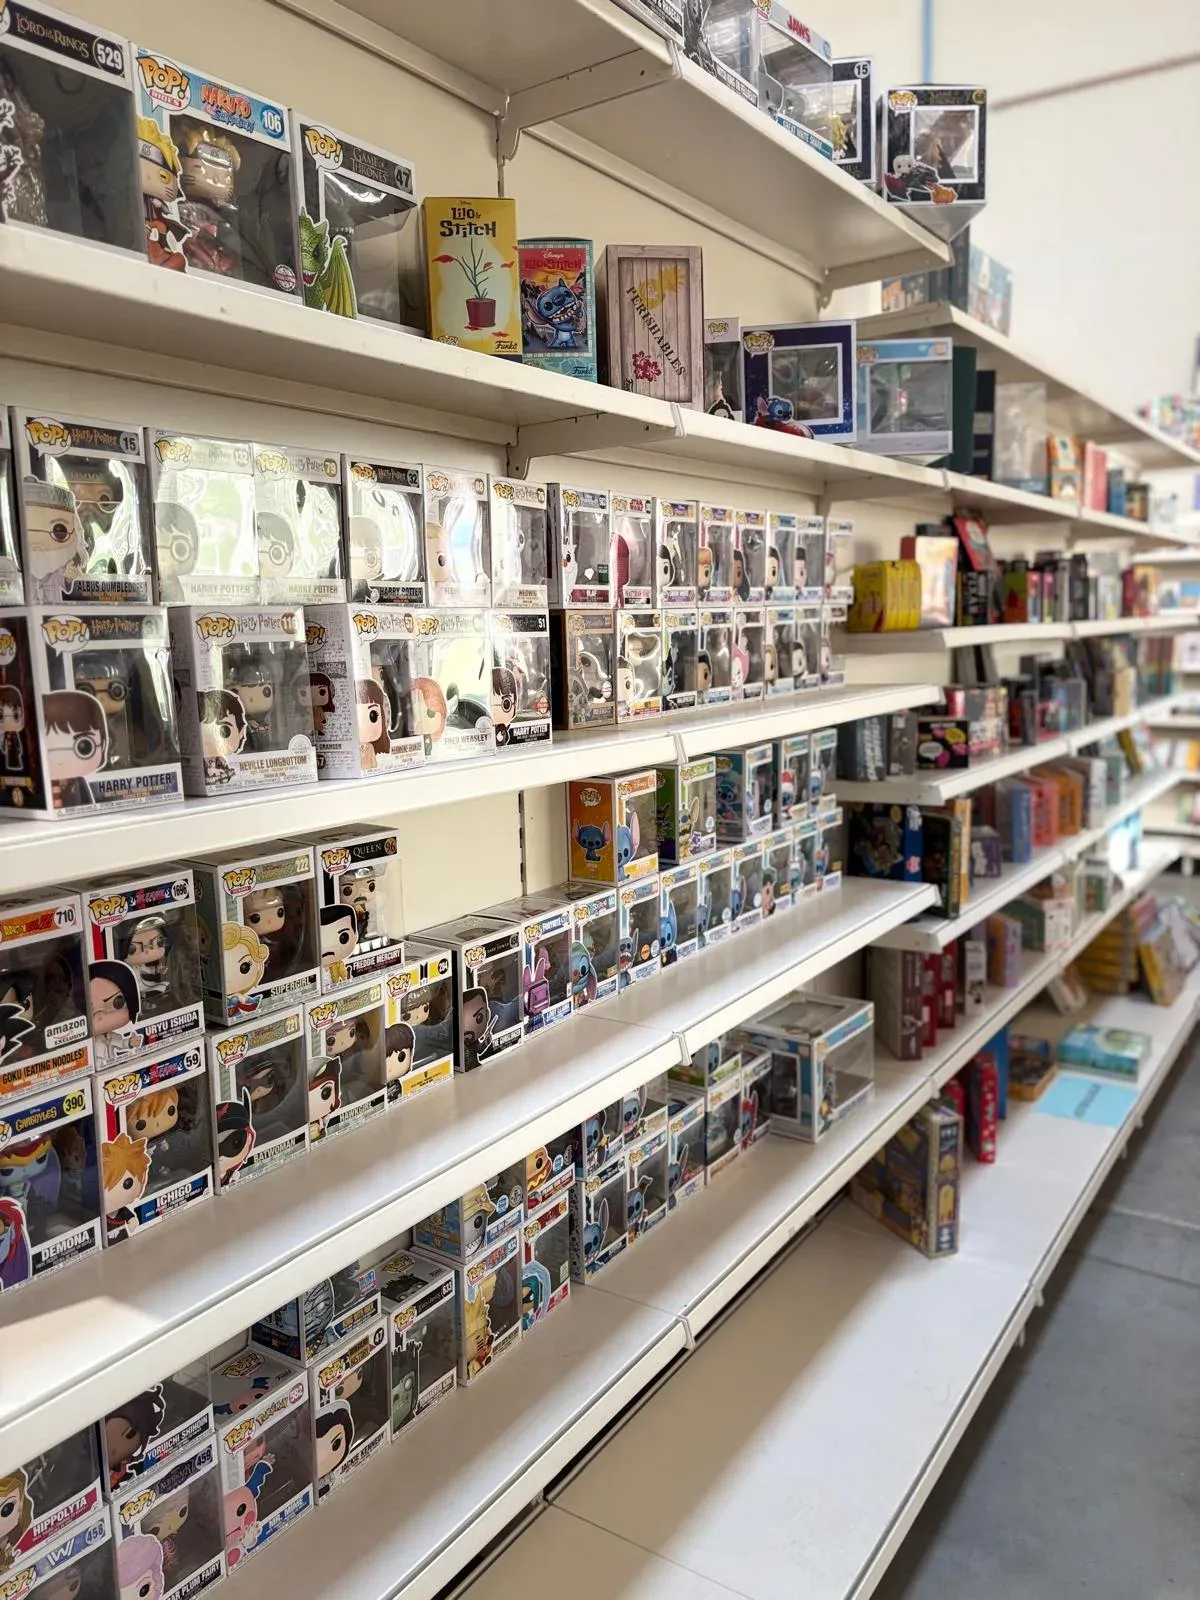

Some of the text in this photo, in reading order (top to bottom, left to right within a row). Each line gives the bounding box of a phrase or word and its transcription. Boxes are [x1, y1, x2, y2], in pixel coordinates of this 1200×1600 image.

[787, 14, 811, 44] JAWS
[16, 13, 122, 70] LORD RINGS 529
[136, 57, 190, 100] POP!
[856, 64, 868, 75] 15
[201, 84, 282, 132] NARUTO 106
[305, 129, 342, 163] POP!
[350, 158, 389, 183] THRONES
[352, 148, 410, 188] GAME 47
[626, 286, 686, 377] PERISHABLES
[708, 320, 729, 335] POP!
[494, 340, 518, 351] Funko
[743, 333, 774, 349] POP!
[572, 366, 594, 376] Funko
[25, 421, 71, 448] POP!
[71, 428, 136, 451] Harry Potter 15
[154, 439, 191, 463] POP!
[235, 450, 249, 465] 132
[256, 453, 288, 475] POP!
[325, 460, 336, 474] 79
[350, 465, 376, 484] POP!
[408, 473, 418, 485] 32
[426, 474, 449, 493] POP!
[475, 480, 484, 493] 88
[493, 483, 515, 500] POP!
[630, 498, 645, 506] STAR
[630, 505, 645, 513] WARS
[77, 581, 99, 593] ALBUS
[190, 584, 249, 594] HARRY POTTER
[288, 584, 338, 594] HARRY POTTER
[379, 587, 423, 597] HARRY POTTER
[41, 619, 87, 643] POP!
[90, 618, 114, 634] Harry
[114, 617, 140, 634] Potter
[195, 616, 237, 641] POP!
[236, 613, 281, 635] Harry Potter
[353, 613, 378, 634] POP!
[538, 618, 546, 628] 51
[444, 734, 488, 746] FRED WEASLEY
[513, 724, 548, 737] HARRY POTTER
[319, 742, 343, 750] GRANGER
[238, 755, 307, 771] NEVILLE LONGBOTTOM
[98, 775, 134, 793] HARRY
[135, 772, 172, 789] POTTER
[321, 847, 350, 867] POP!
[352, 838, 396, 858] QUEEN 96
[295, 855, 309, 873] 222
[222, 867, 257, 890] POP!
[172, 883, 188, 898] 1696
[622, 891, 636, 904] POP!
[56, 906, 74, 924] 710
[88, 895, 127, 920] POP!
[574, 905, 589, 920] POP!
[524, 924, 542, 940] POP!
[542, 917, 561, 932] FORTNITE
[352, 950, 401, 970] FREDDIE MERCURY
[465, 946, 486, 966] POP!
[270, 975, 311, 997] SUPERGIRL
[387, 972, 412, 994] POP!
[309, 1002, 338, 1022] POP!
[46, 1017, 86, 1038] amazon
[145, 1011, 198, 1036] URYU ISHIDA
[286, 1017, 298, 1034] 221
[54, 1032, 86, 1046] EXCLUSIVE
[216, 1034, 249, 1058] POP!
[2, 1048, 85, 1084] GOKU (EATING NOODLES)
[186, 1052, 199, 1068] 59
[104, 1073, 142, 1098] POP!
[15, 1106, 57, 1132] GARGOYLES
[64, 1094, 84, 1111] 390
[339, 1101, 373, 1121] HAWKGIRL
[253, 1138, 296, 1164] BATWOMAN
[156, 1183, 193, 1208] ICHIGO
[524, 1222, 541, 1239] POP!
[41, 1229, 90, 1262] DEMONA
[467, 1262, 487, 1281] POP!
[394, 1306, 417, 1327] POP!
[318, 1359, 346, 1386] POP!
[289, 1383, 304, 1402] 582
[146, 1415, 210, 1460] YORUICHI SHIHOIN
[225, 1418, 255, 1447] POP!
[196, 1447, 213, 1468] 459
[339, 1431, 386, 1475] JACKIE KENNEDY
[119, 1489, 157, 1522] POP!
[268, 1497, 305, 1528] MR. MIME
[32, 1494, 88, 1538] HIPPOLYTA
[86, 1522, 104, 1545] 458
[181, 1560, 221, 1596] PLUM FAIRY
